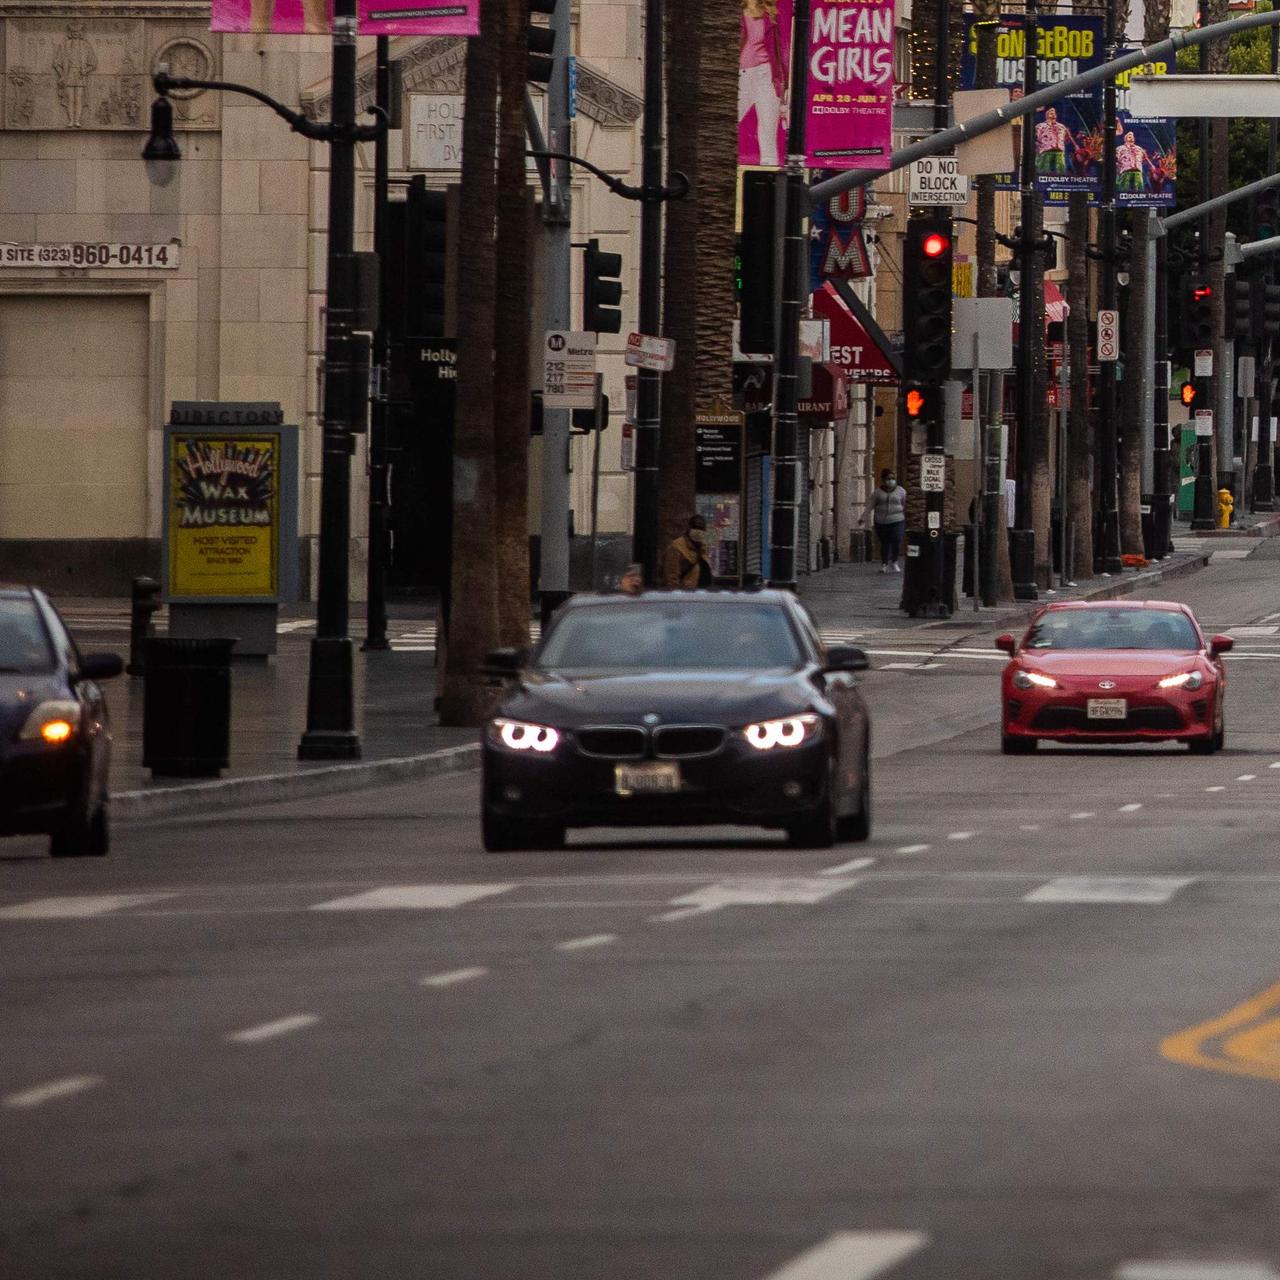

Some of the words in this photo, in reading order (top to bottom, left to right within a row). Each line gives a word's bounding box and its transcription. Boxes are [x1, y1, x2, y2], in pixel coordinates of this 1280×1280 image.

[812, 7, 892, 44] MEAN
[811, 46, 892, 85] GIRLS
[813, 94, 834, 103] APR
[880, 95, 888, 103] 7
[823, 106, 850, 114] DOLBY
[853, 106, 887, 115] THEATRE
[416, 123, 456, 139] FIRST
[917, 160, 932, 174] DO
[938, 160, 960, 174] NOT
[919, 176, 958, 190] BLOCK
[1048, 176, 1069, 184] DOLBY
[1070, 176, 1098, 184] THEATRE
[911, 192, 966, 201] INTERSECTION
[7, 246, 35, 262] SITE
[38, 245, 70, 263] (323)
[72, 243, 169, 266] 960-0414
[546, 362, 564, 371] 212
[546, 373, 564, 382] 217
[171, 409, 284, 424] DIRECTORY
[186, 444, 263, 486] Hollywood
[180, 505, 272, 525] MUSEUM
[192, 536, 221, 546] MOST
[223, 536, 258, 546] VISITED
[198, 547, 253, 556] ATTRACTION
